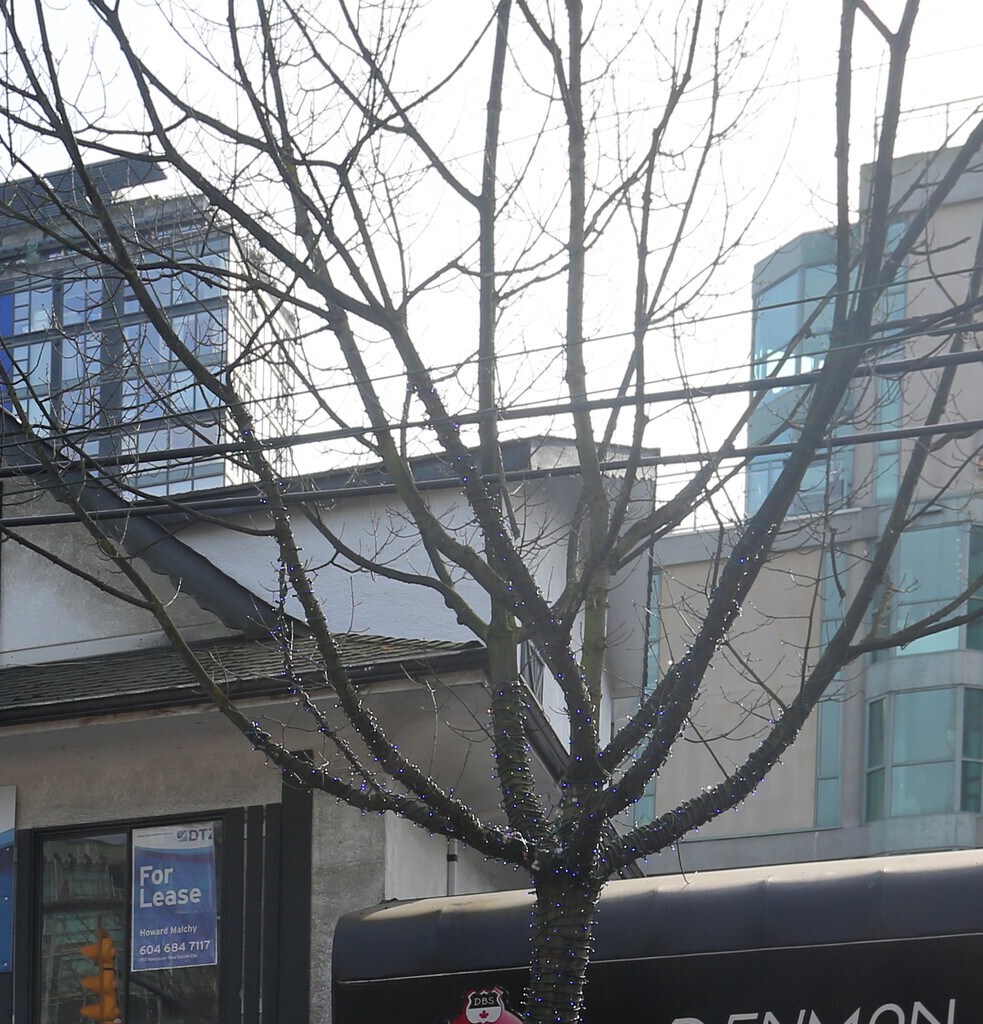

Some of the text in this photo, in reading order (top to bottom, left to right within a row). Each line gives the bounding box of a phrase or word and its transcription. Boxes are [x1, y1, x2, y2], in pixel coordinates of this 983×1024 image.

[140, 866, 173, 886] For
[140, 887, 201, 908] Lease
[140, 925, 197, 936] Howard Malchy
[140, 941, 210, 955] 604 684 7117
[474, 997, 494, 1006] DBS
